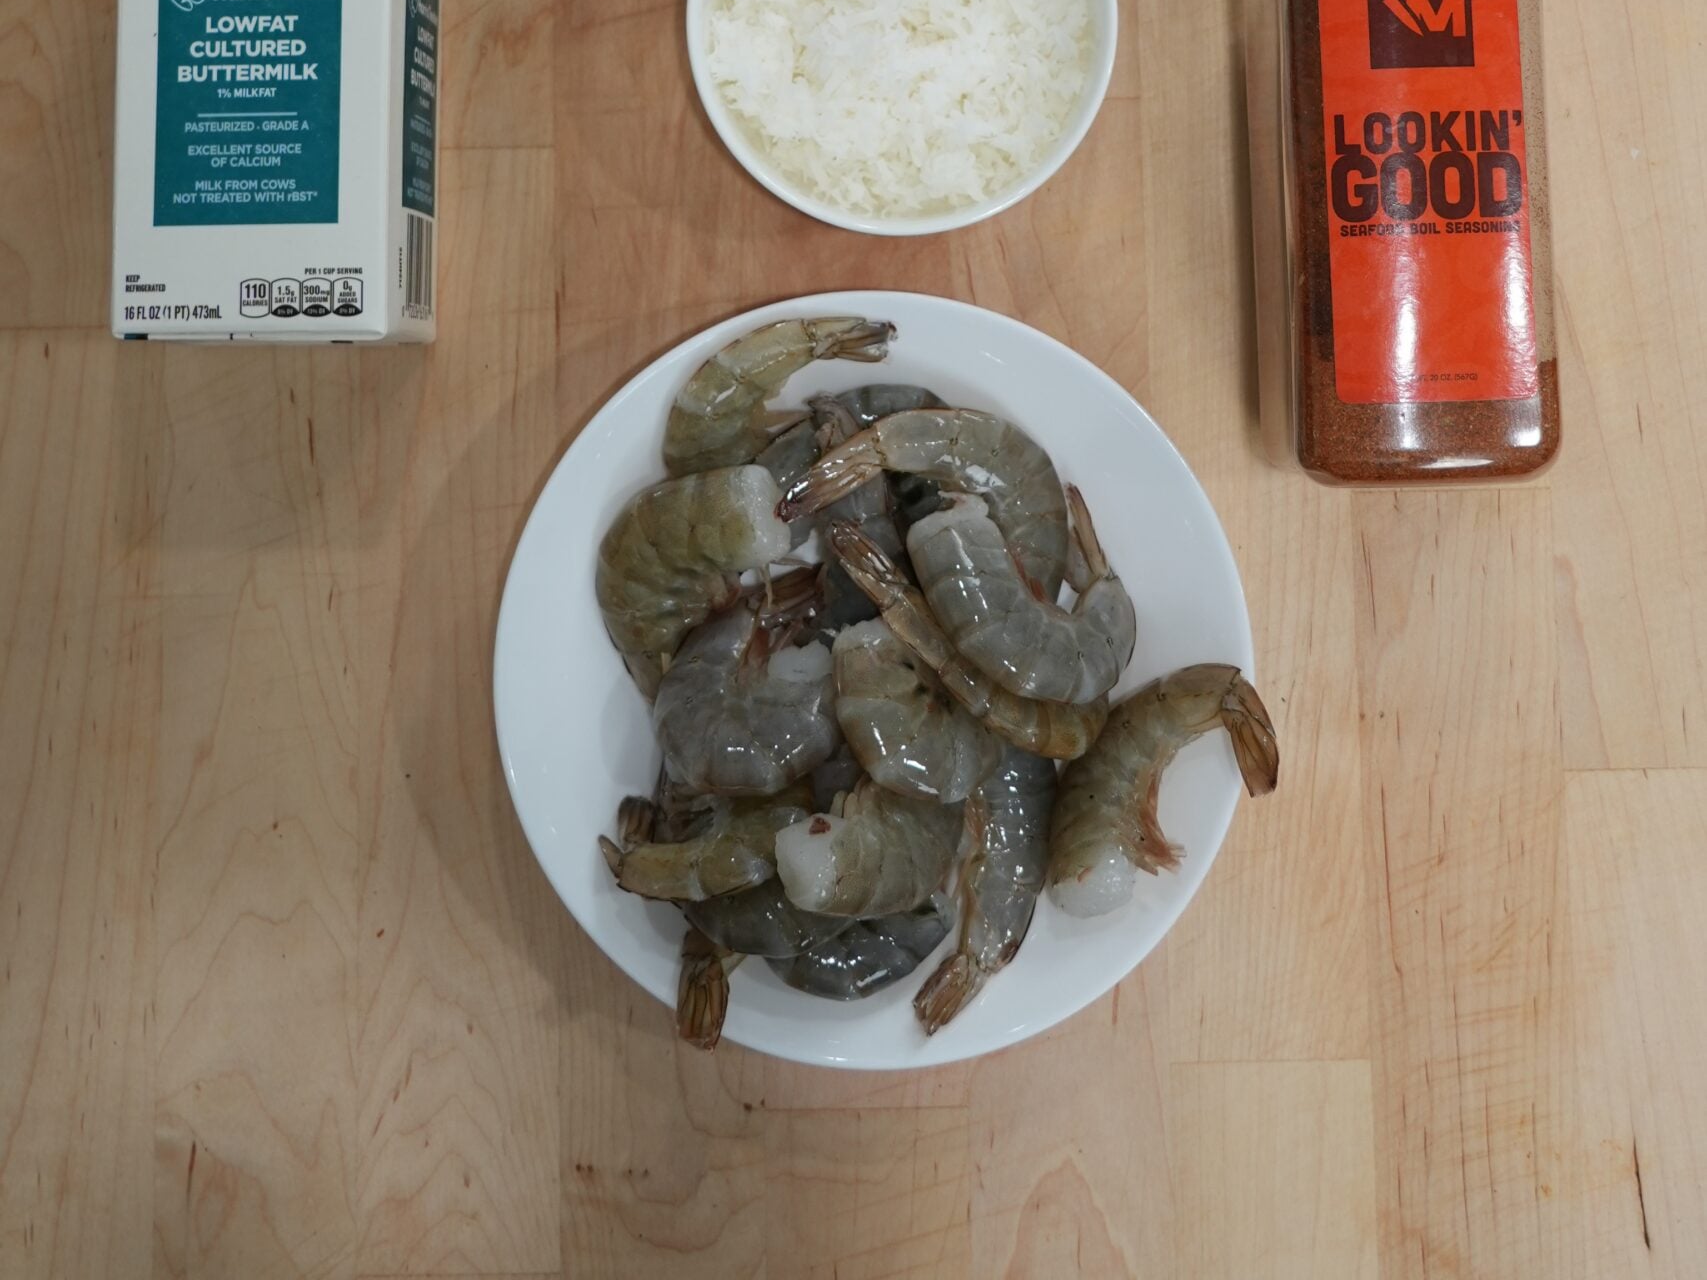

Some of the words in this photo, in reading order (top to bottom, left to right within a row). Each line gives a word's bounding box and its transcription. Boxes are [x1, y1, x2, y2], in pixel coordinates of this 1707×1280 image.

[206, 15, 299, 34] LOWFAT
[190, 40, 307, 58] CULTURED
[177, 63, 318, 83] BUTTERMILK
[217, 88, 232, 98] 1%
[234, 87, 277, 98] MILKFAT
[185, 122, 255, 133] PASTEURIZED
[262, 120, 299, 131] GRADE
[301, 121, 309, 131] A
[187, 145, 251, 156] EXCELLENT
[255, 143, 302, 155] SOURCE
[211, 158, 227, 168] OF
[230, 156, 281, 167] CALCIUM
[195, 180, 221, 191] MILK
[225, 180, 258, 191] FROM
[260, 179, 296, 190] COWS
[1331, 151, 1522, 222] GOOD
[173, 193, 197, 204] NOT
[200, 192, 251, 203] TREATED
[254, 191, 284, 203] WITH
[1410, 222, 1440, 234] BOIL
[304, 267, 317, 275] PER
[323, 267, 335, 275] CUP
[337, 266, 363, 274] SERVING
[125, 275, 140, 283] KEEP
[245, 283, 266, 298] 110
[277, 285, 295, 297] 1.5g
[303, 285, 330, 296] 300mg
[343, 280, 353, 291] 0g
[124, 307, 135, 319] 16
[137, 307, 148, 319] FL
[149, 306, 161, 318] OZ
[173, 305, 190, 319] PT)
[192, 305, 222, 318] 473mL
[1430, 373, 1439, 382] 20
[1454, 372, 1478, 381] (567G)
